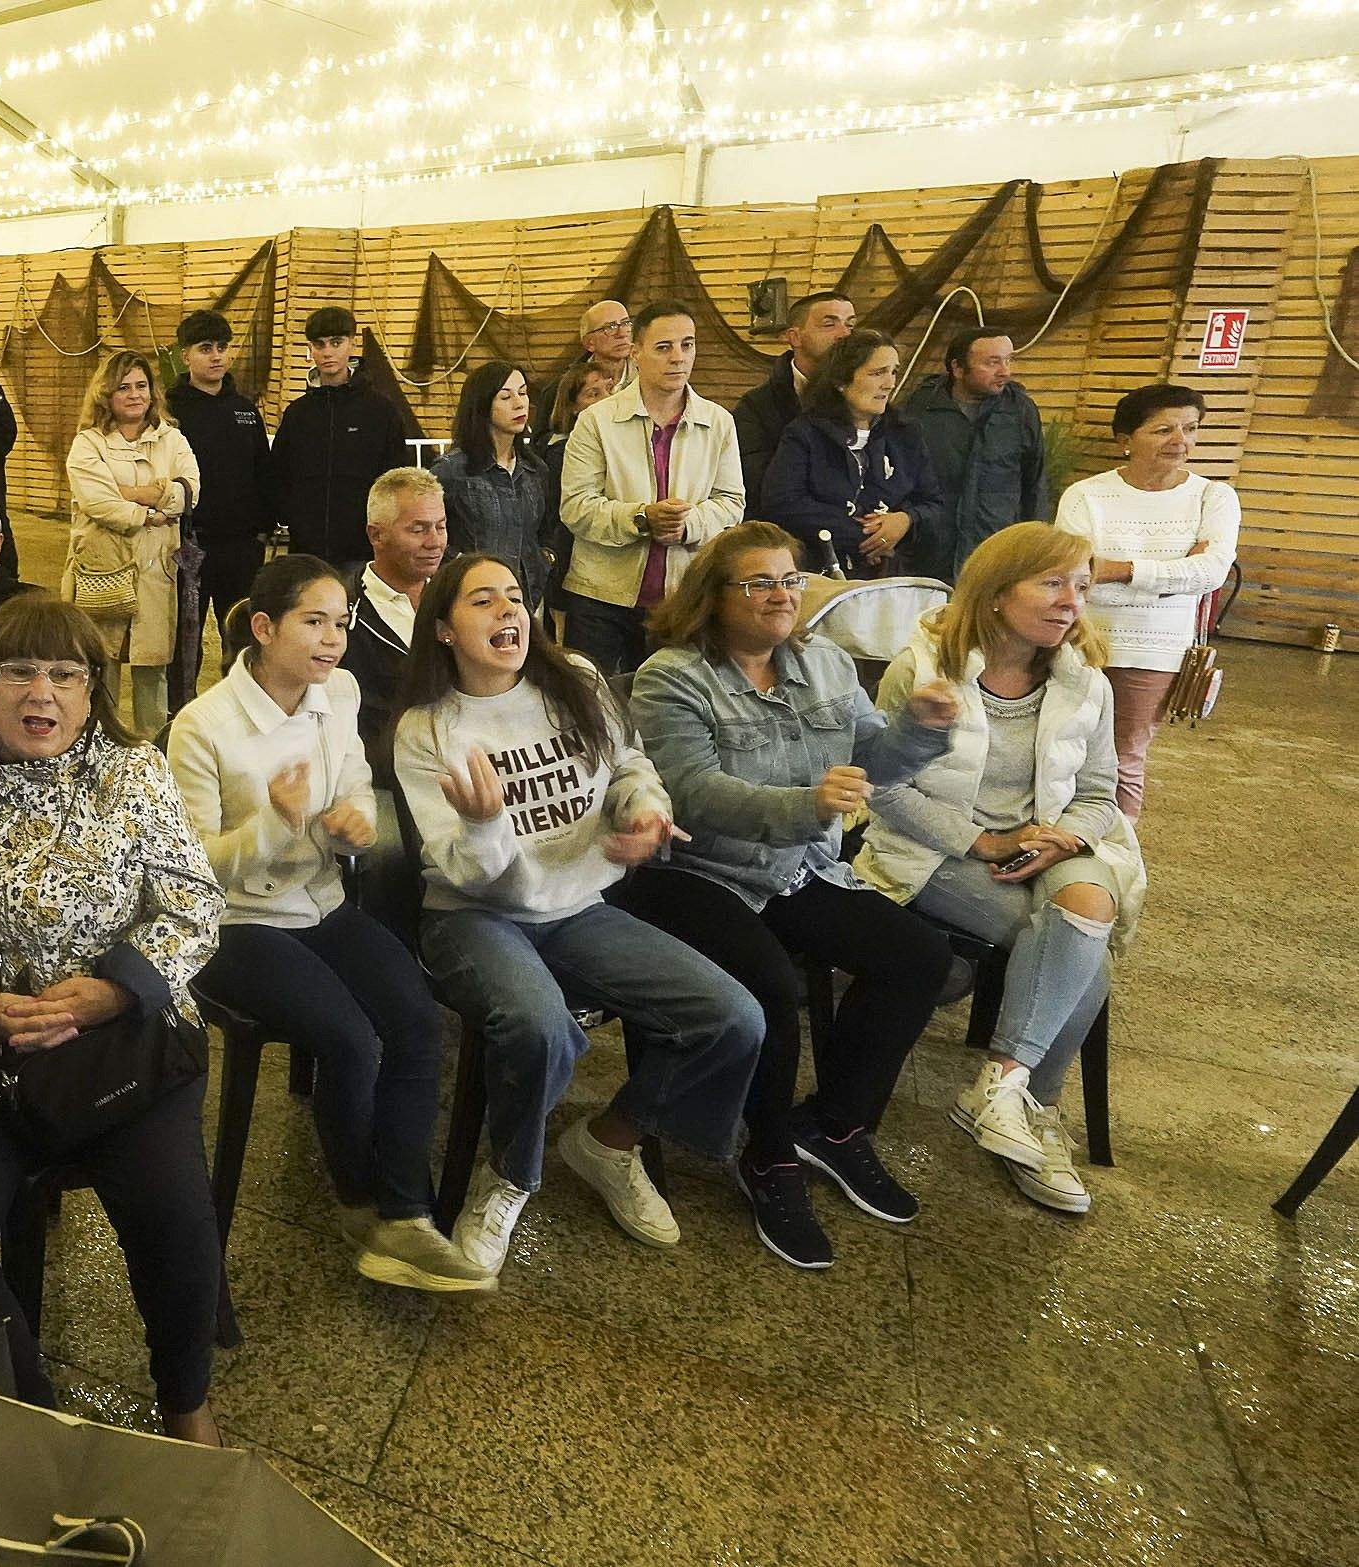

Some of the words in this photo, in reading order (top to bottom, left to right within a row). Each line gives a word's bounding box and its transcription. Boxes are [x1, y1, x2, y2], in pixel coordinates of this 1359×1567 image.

[487, 730, 587, 776] HILLIN
[501, 764, 580, 806] WITH
[510, 787, 595, 836] RIENDS
